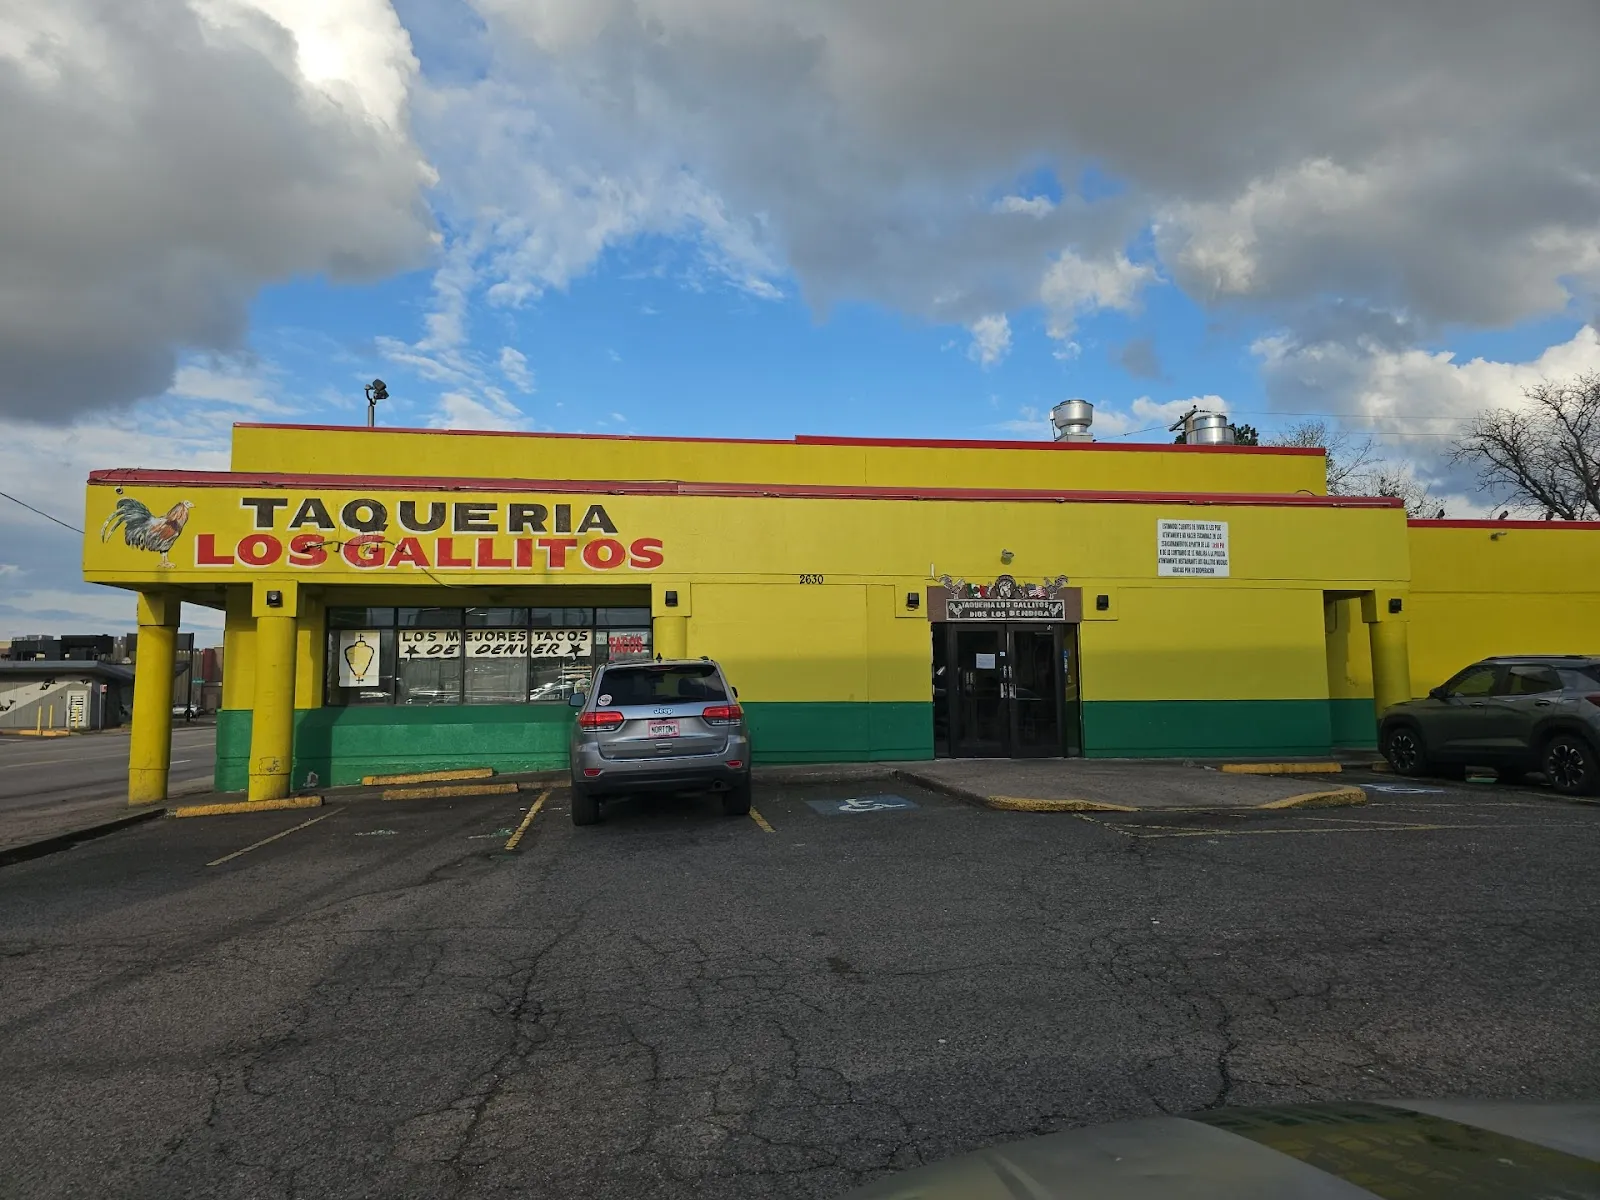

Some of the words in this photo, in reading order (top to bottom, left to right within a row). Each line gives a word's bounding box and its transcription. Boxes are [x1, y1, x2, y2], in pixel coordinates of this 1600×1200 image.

[240, 497, 619, 535] TAQUERIA
[195, 533, 328, 569] LOS
[342, 534, 664, 571] GALLITOS
[799, 574, 824, 585] 2630
[962, 601, 995, 609] TAQUERIA
[402, 631, 437, 642] LOS
[445, 630, 527, 642] MEJORES
[534, 630, 588, 642] TACOS
[426, 643, 460, 655] DE
[474, 643, 560, 655] DENVER
[653, 707, 673, 715] Jeep
